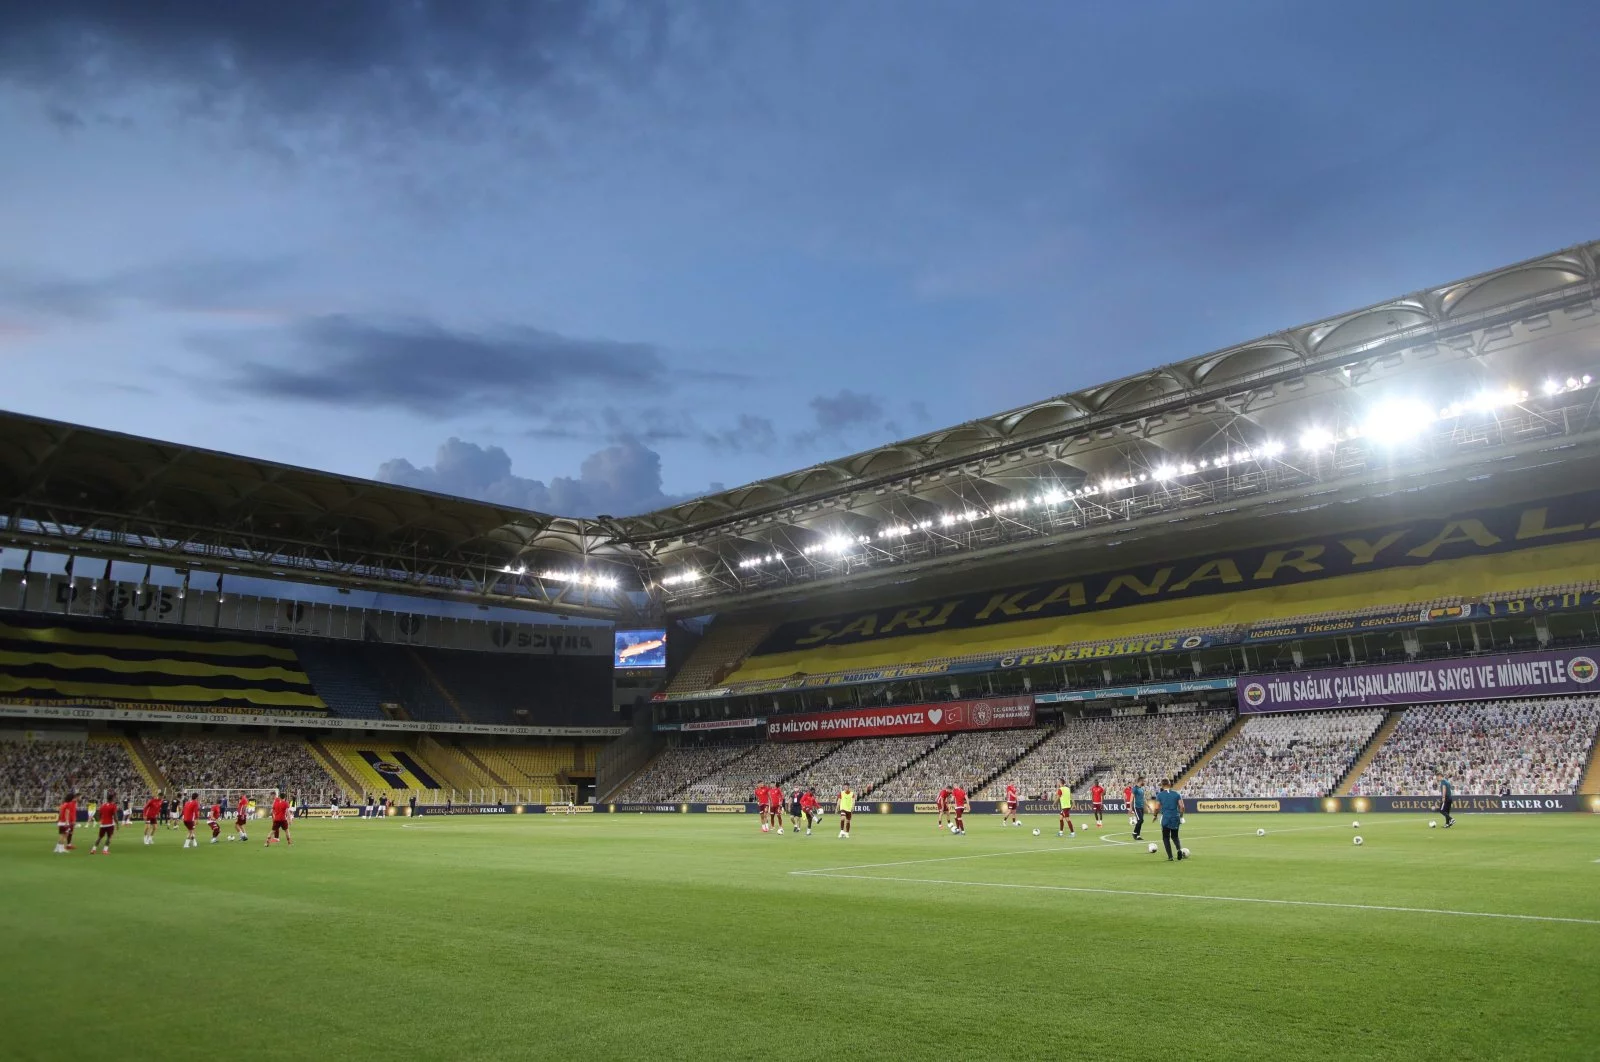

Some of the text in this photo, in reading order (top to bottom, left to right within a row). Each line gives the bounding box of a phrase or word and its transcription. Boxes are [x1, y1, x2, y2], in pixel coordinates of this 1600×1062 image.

[795, 507, 1600, 645] SARI KANARYAL
[1268, 679, 1292, 703] TÜM
[1294, 675, 1333, 701] SAĞLIK
[1334, 670, 1437, 703] ÇALIŞANLARIMIZA
[1438, 667, 1475, 691] SAYGI
[1476, 665, 1496, 688] VE
[1497, 659, 1567, 687] MİNNETLE
[769, 712, 924, 733] 83 MİLYON #AYNITAKIMDAYIZ!
[1473, 798, 1499, 811] İÇİN
[1501, 800, 1542, 809] FENER
[1546, 800, 1563, 809] OL
